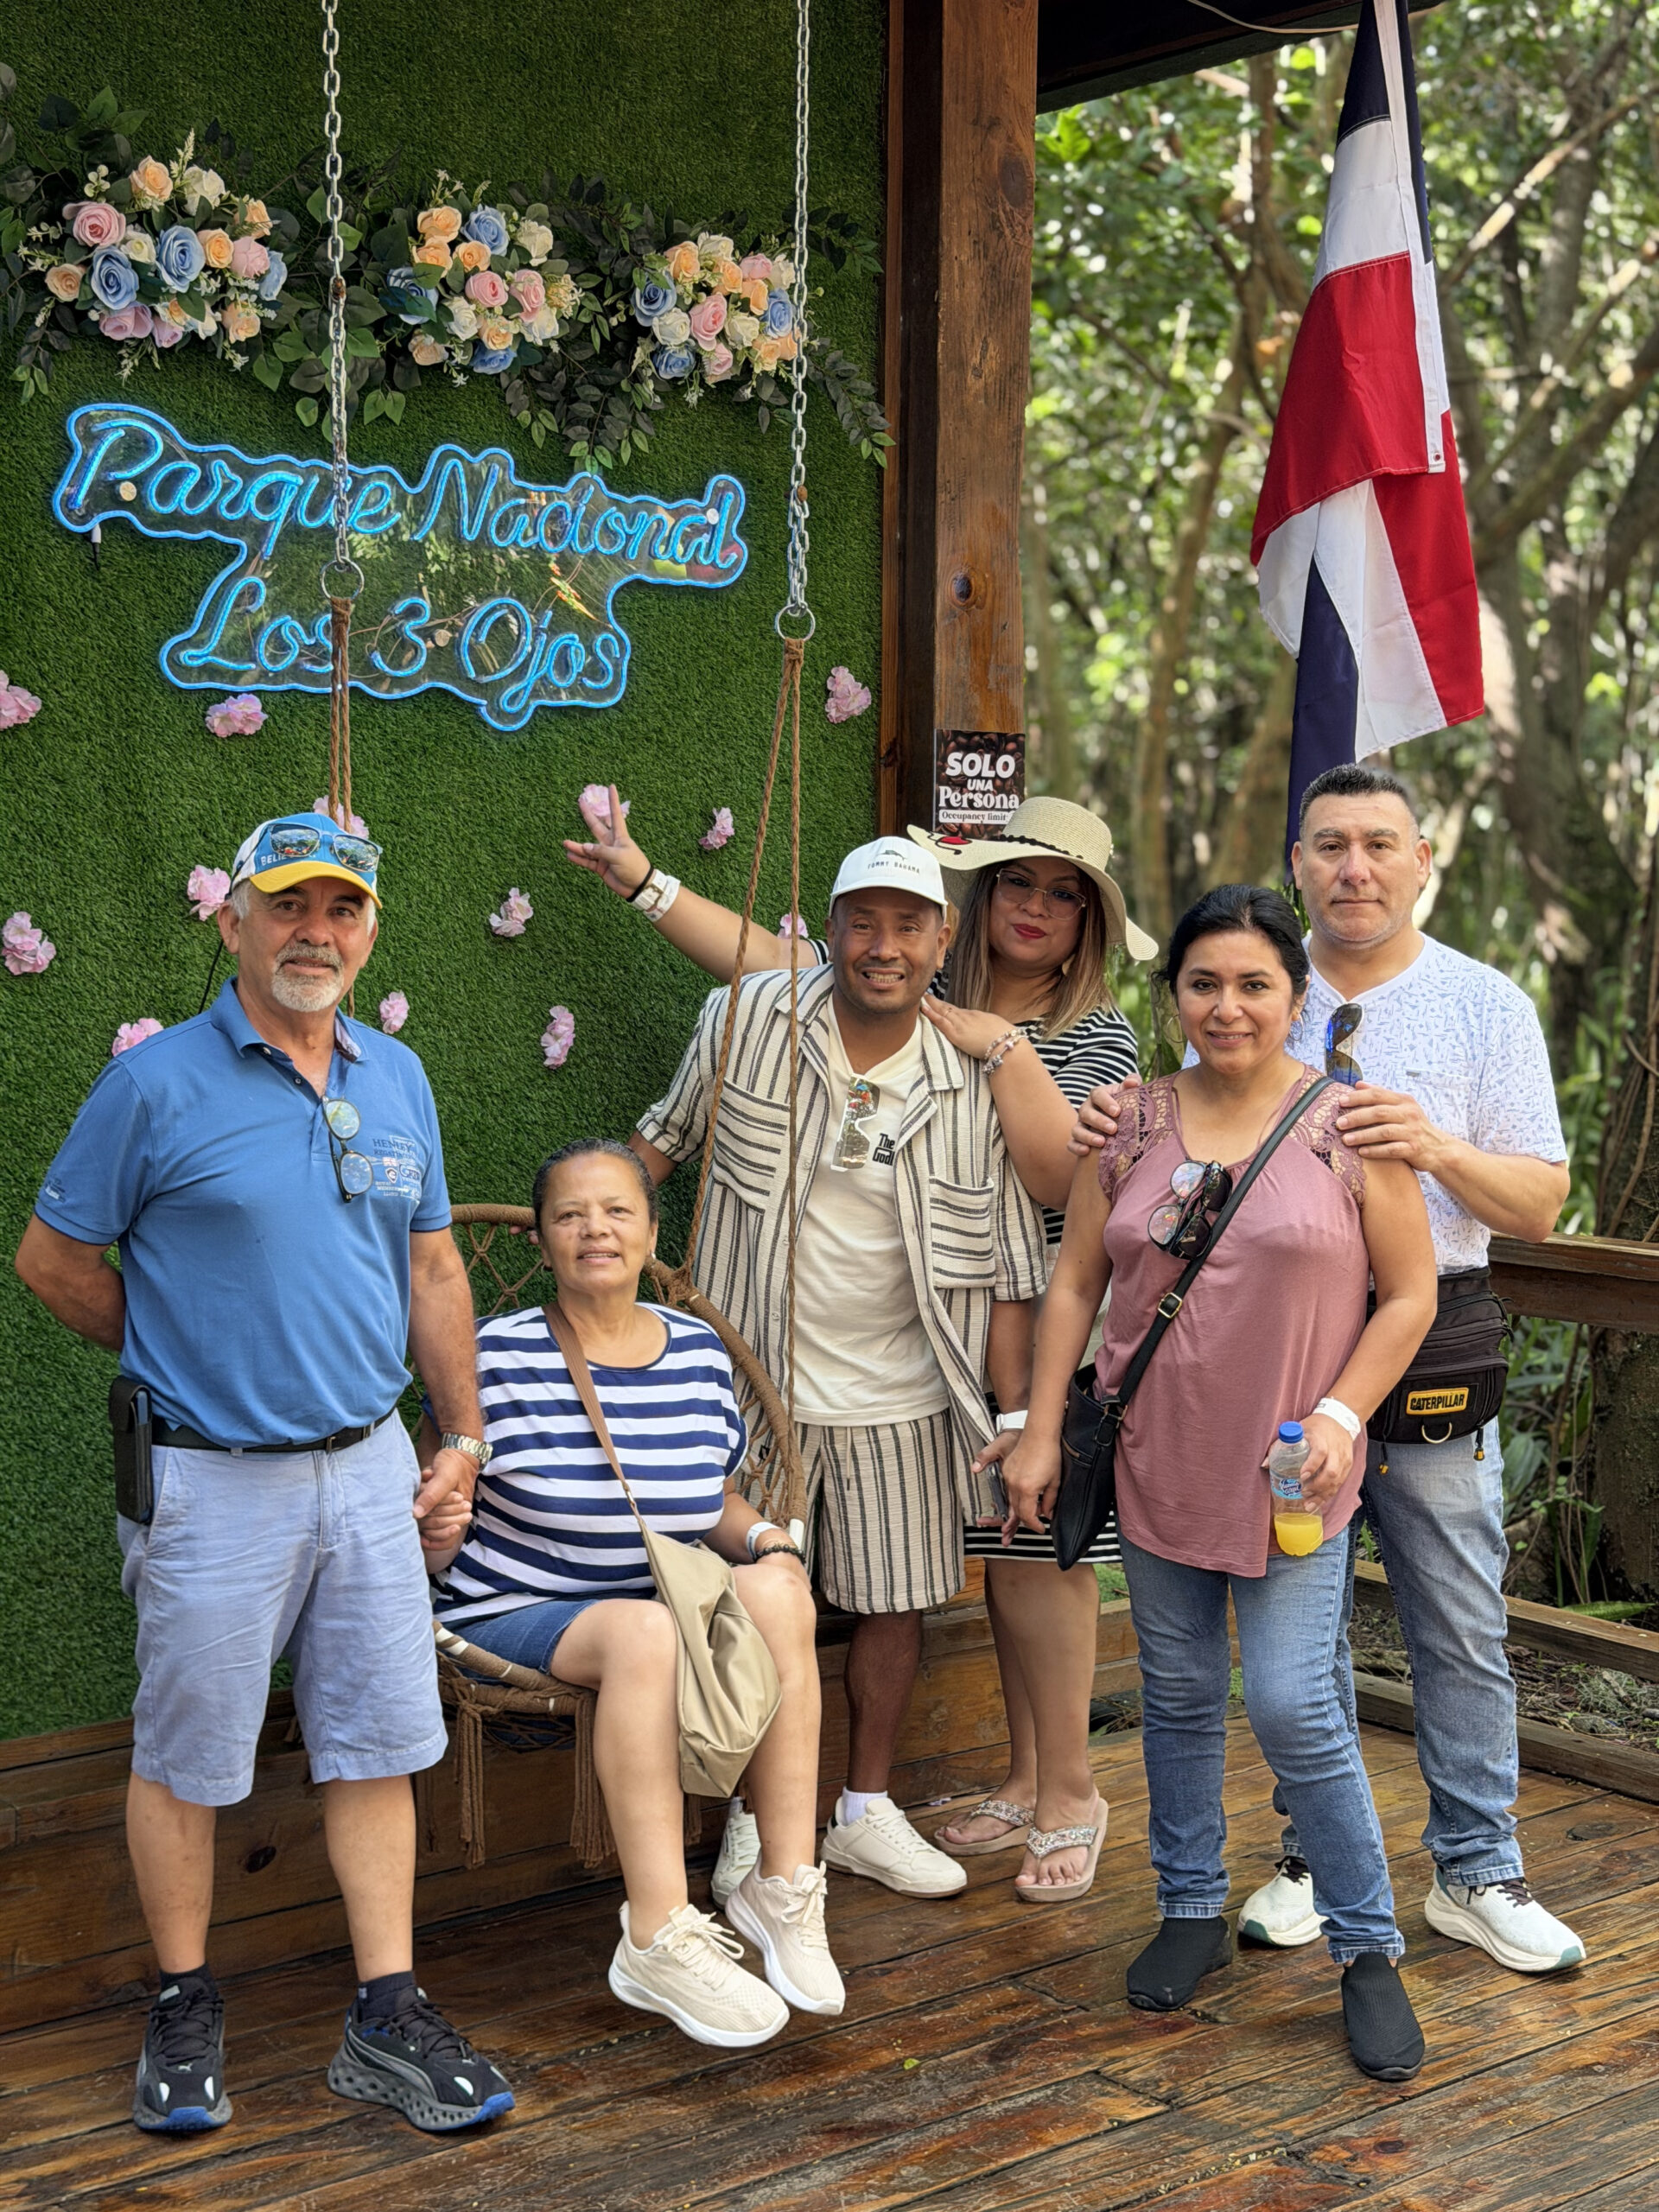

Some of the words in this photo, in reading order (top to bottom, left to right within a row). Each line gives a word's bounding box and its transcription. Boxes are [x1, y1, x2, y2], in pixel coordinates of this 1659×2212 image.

[67, 418, 402, 560] Parque
[410, 458, 738, 569] Nacional
[181, 576, 337, 674] Los
[371, 597, 431, 677] 3
[459, 596, 621, 715] Ojos
[945, 752, 1016, 779] SOLO
[967, 779, 994, 791] UNA
[938, 785, 1020, 810] Persona
[942, 810, 986, 822] Occupancy
[260, 853, 287, 866] BELI
[868, 861, 889, 869] TOMMY
[894, 861, 920, 874] BAHAMA
[372, 1139, 413, 1152] HENLEY
[879, 1133, 895, 1149] The
[1410, 1394, 1465, 1410] CATERPILLAR
